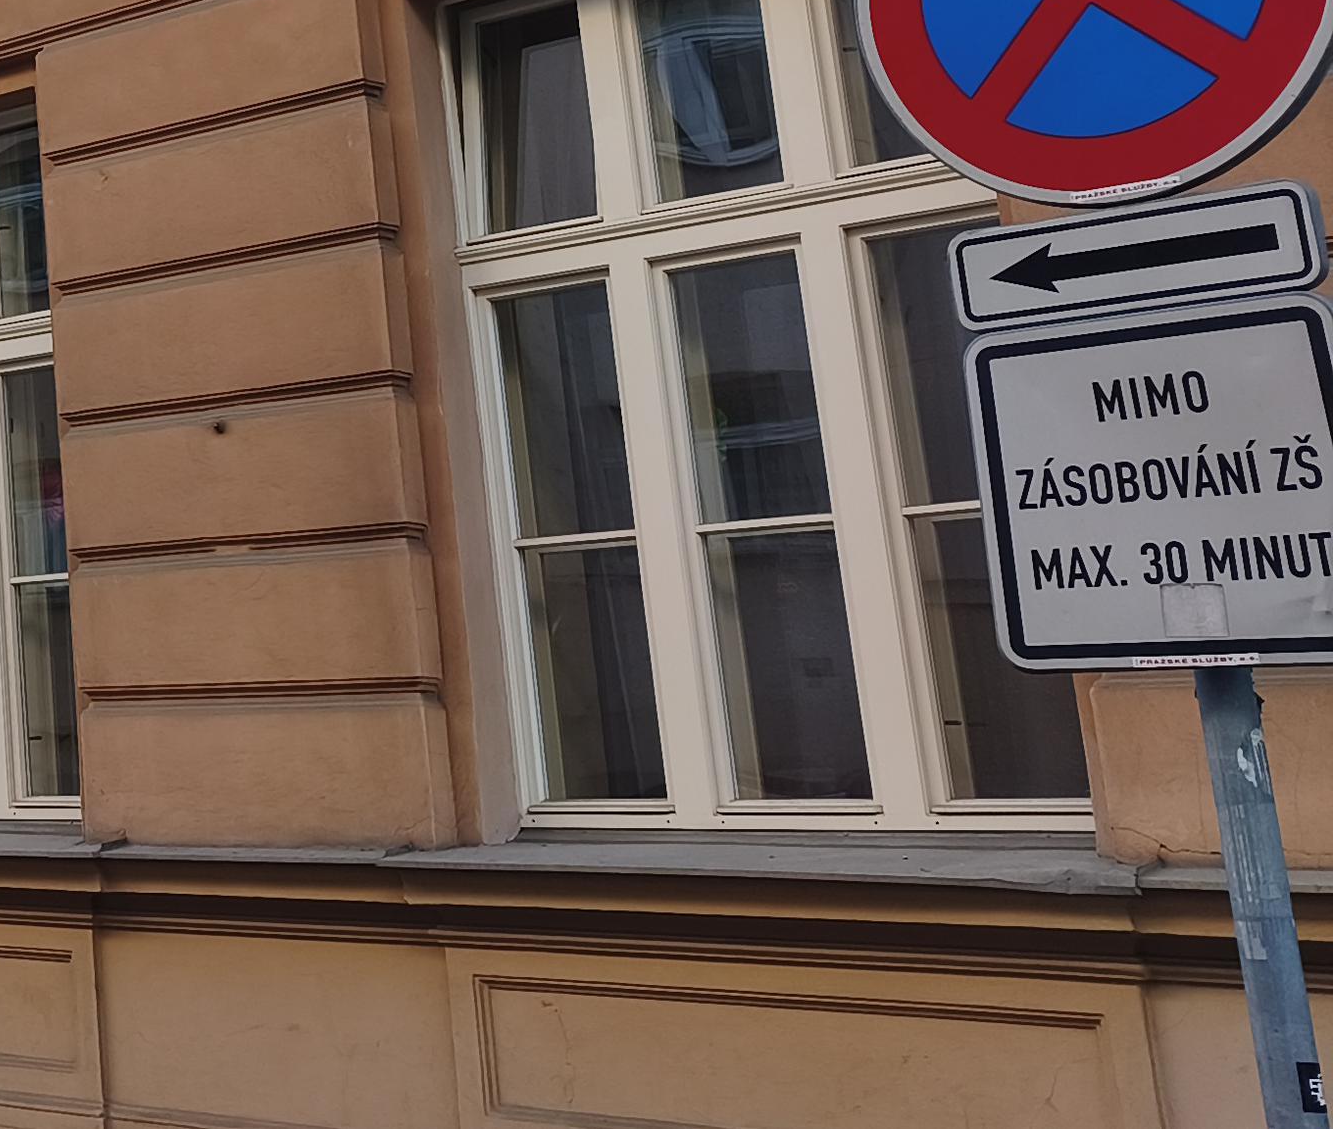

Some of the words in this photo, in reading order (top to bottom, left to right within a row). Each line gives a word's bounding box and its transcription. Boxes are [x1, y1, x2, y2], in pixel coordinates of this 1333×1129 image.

[1092, 371, 1209, 422] MIMO
[1015, 439, 1261, 510] ZÁSOBOVÁNÍ
[1270, 434, 1323, 492] ZŠ
[1030, 544, 1129, 590] MAX.
[1140, 540, 1189, 585] 30
[1201, 531, 1332, 582] MINUT
